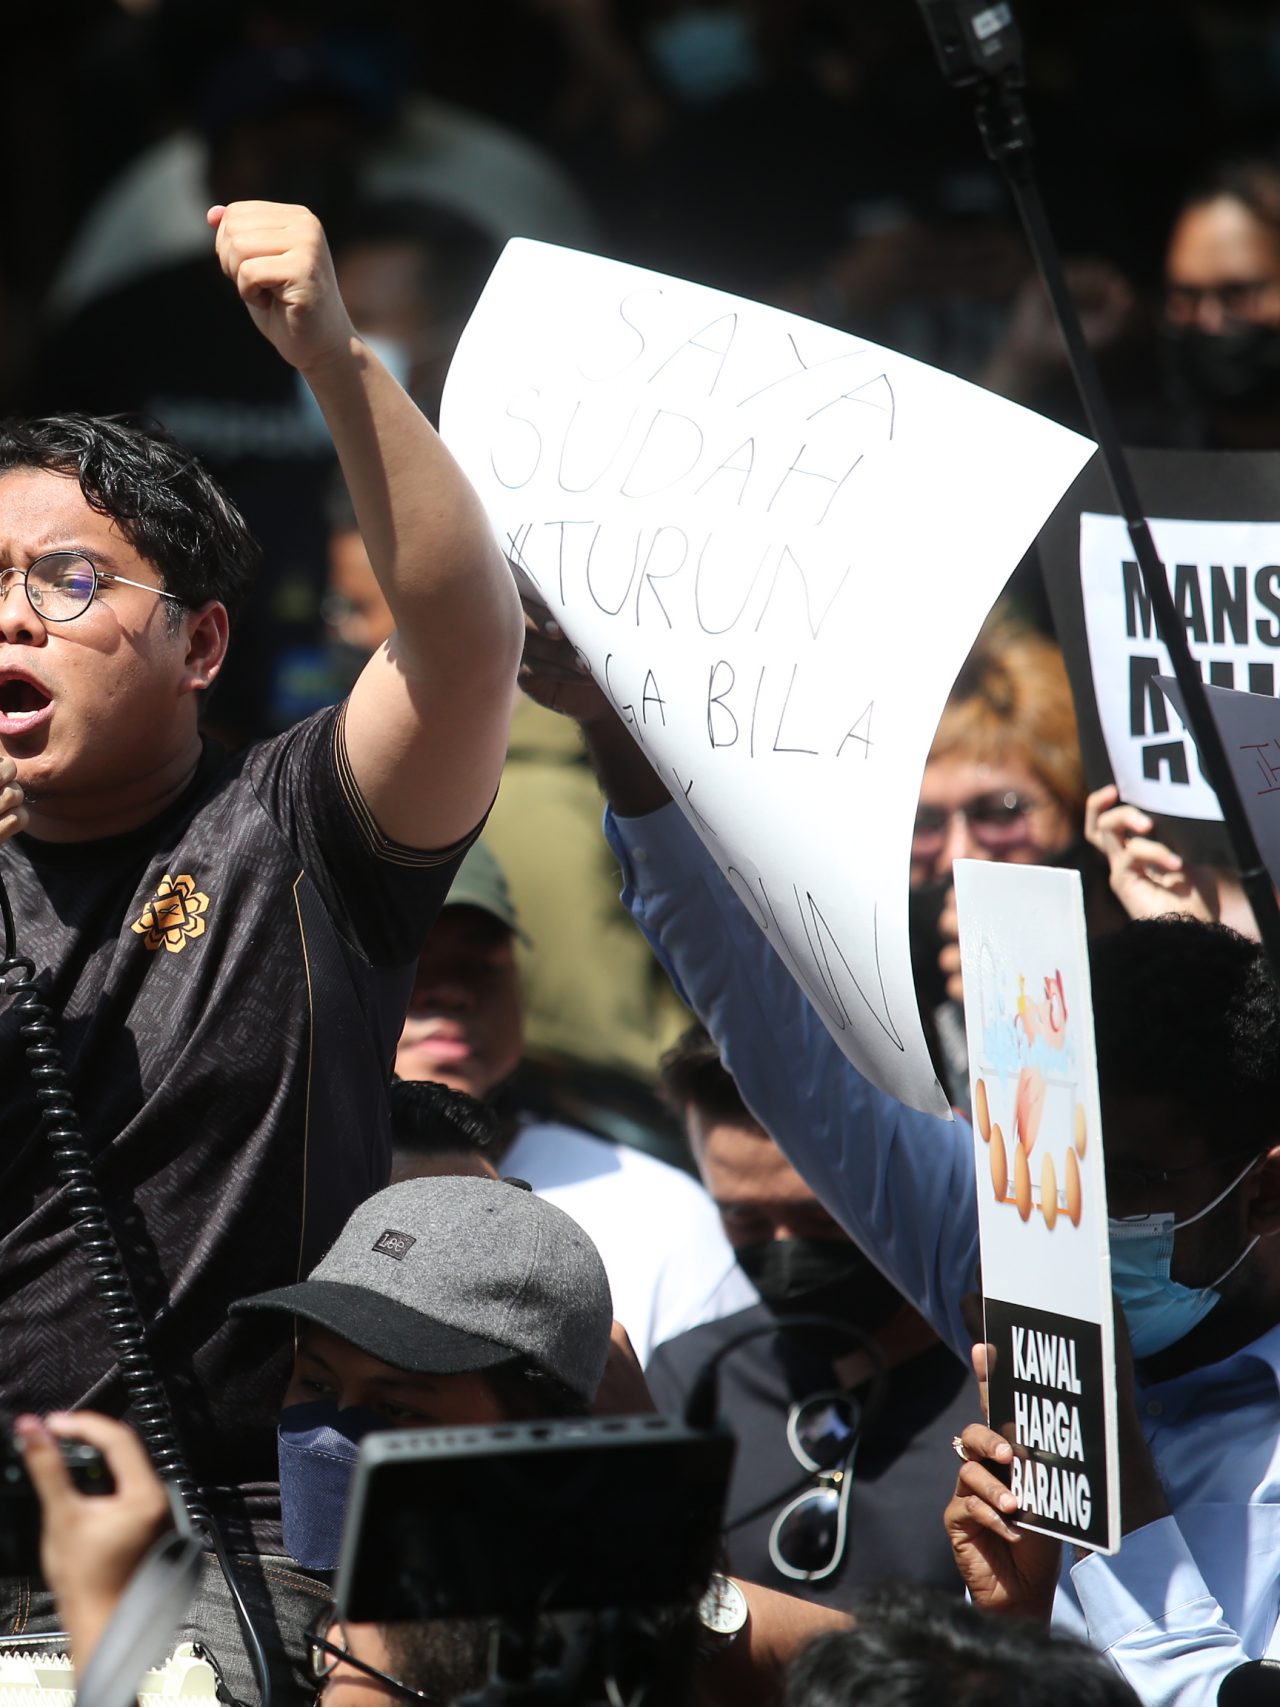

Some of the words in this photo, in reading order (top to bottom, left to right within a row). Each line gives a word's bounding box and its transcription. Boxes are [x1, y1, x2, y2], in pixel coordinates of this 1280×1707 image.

[576, 288, 895, 440] SAYA
[490, 387, 864, 526] SUDAH
[707, 660, 874, 759] BILA
[378, 1233, 405, 1252] Lee
[1011, 1325, 1082, 1395] KAWAL
[1014, 1391, 1085, 1462] HARGA
[1010, 1455, 1091, 1531] BARANG
